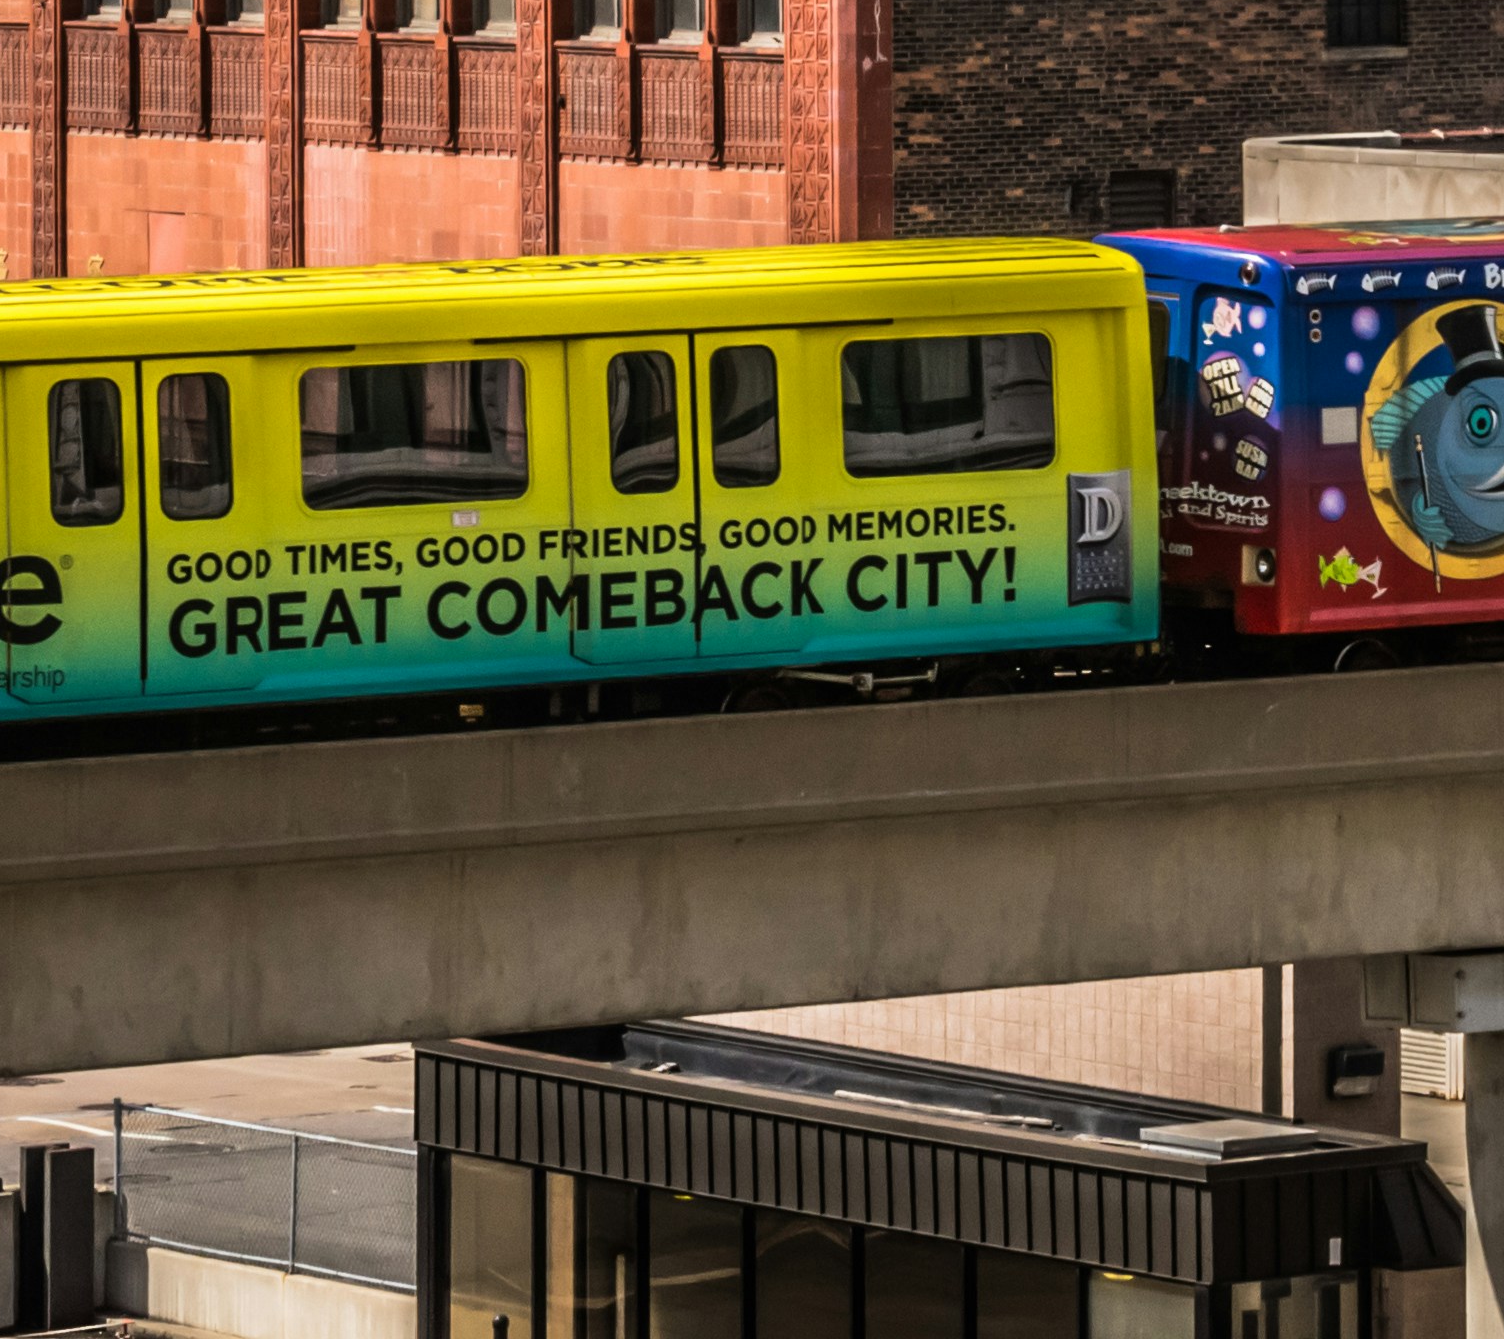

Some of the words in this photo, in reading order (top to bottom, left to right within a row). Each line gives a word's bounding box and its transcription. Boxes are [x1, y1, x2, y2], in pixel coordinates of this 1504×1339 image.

[1202, 358, 1240, 380] OPEN
[1076, 487, 1123, 543] D
[1160, 481, 1270, 509] reektown
[1177, 503, 1212, 517] and
[1214, 506, 1269, 527] Spirits
[167, 548, 272, 585] GOOD
[284, 540, 404, 576] TIMES,
[415, 532, 526, 568] GOOD
[538, 522, 707, 560] FRIENDS,
[718, 514, 817, 550] GOOD
[827, 503, 1016, 543] MEMORIES.
[168, 585, 402, 659] GREAT
[426, 557, 825, 640] COMEBACK
[845, 546, 1017, 613] CITY!
